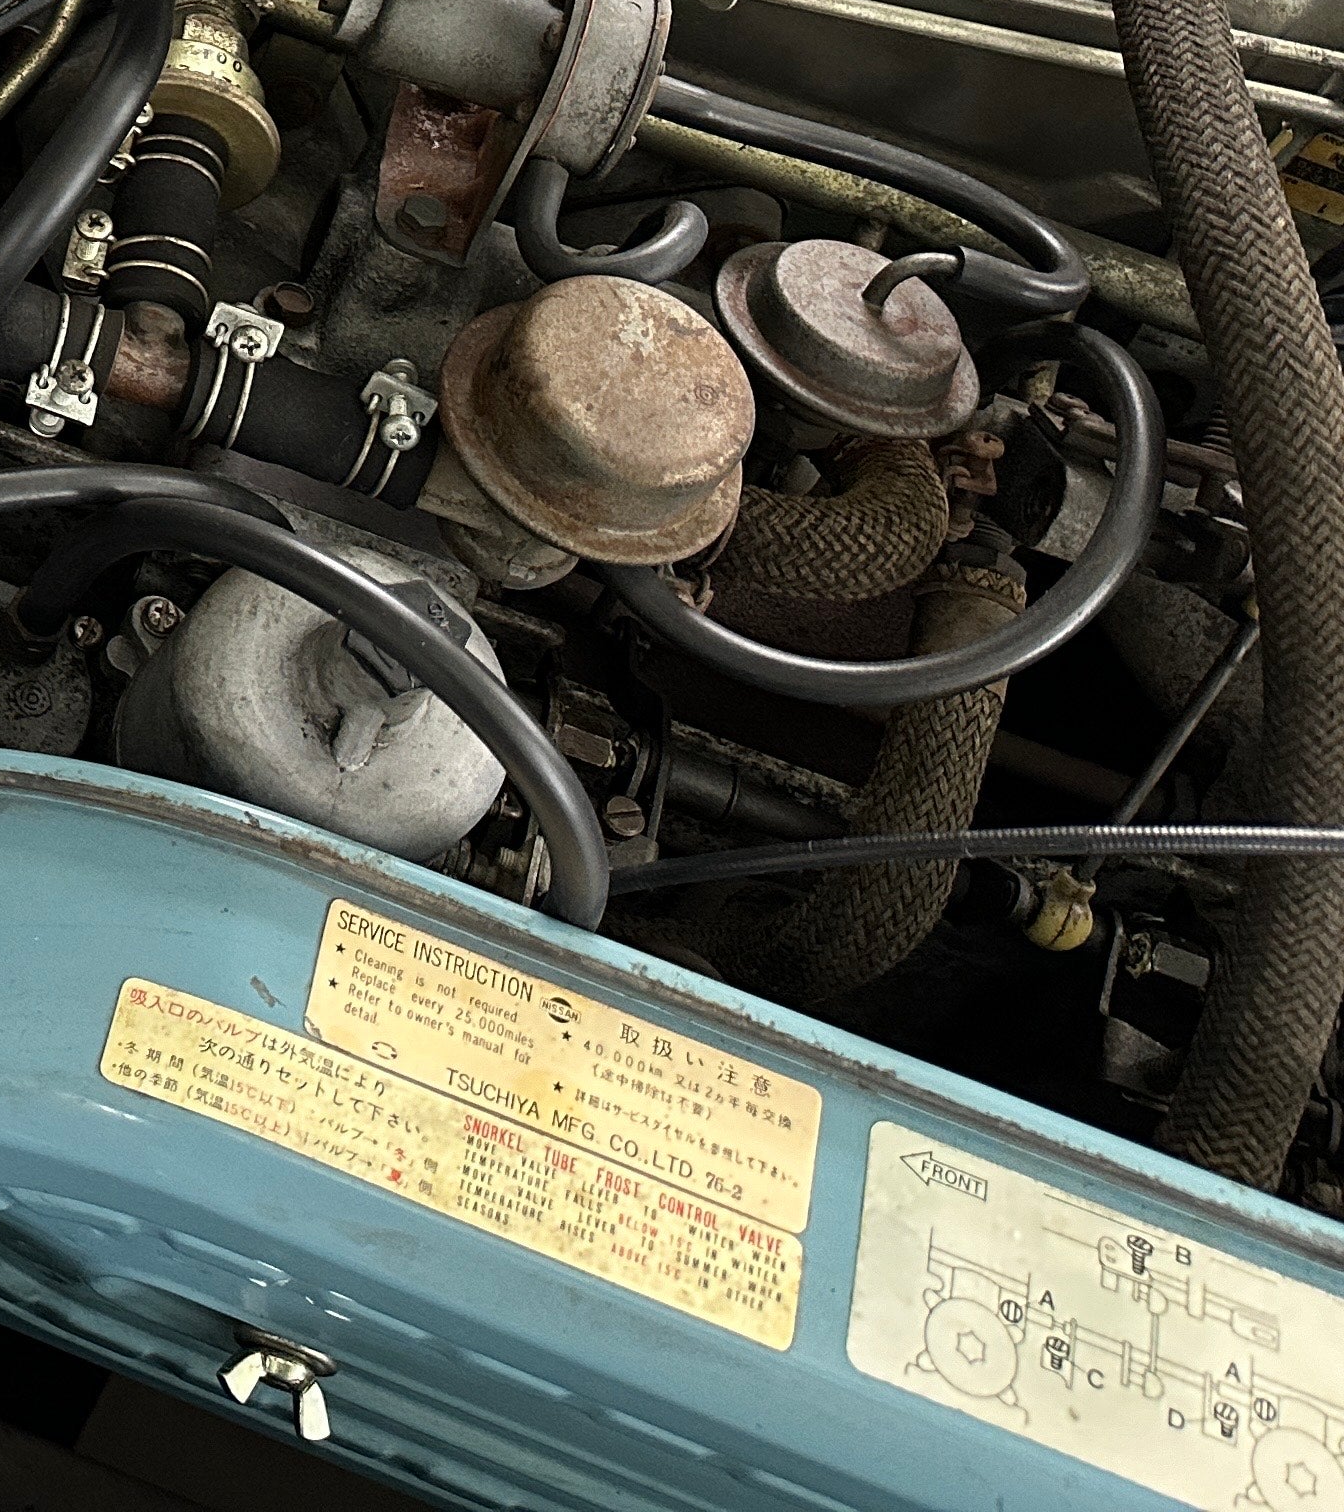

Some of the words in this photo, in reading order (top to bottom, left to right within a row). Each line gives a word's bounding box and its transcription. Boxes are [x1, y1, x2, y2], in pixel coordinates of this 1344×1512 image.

[334, 909, 410, 953] SERVICE
[409, 940, 536, 1003] INSTRUCTION
[348, 965, 398, 995] Replace
[408, 991, 445, 1015] every
[351, 947, 406, 981] Cleaning
[413, 972, 427, 987] is
[434, 980, 458, 999] not
[466, 994, 519, 1025] required
[345, 982, 382, 1008] Refer
[385, 998, 404, 1017] to
[404, 1006, 457, 1037] owner's
[459, 1029, 505, 1057] manual
[511, 1047, 532, 1066] for
[614, 1021, 776, 1099] 取扱い注意
[442, 1067, 544, 1121] TSUCHIYA
[548, 1108, 605, 1143] MFG.
[701, 1170, 746, 1202] 76-2
[459, 1113, 528, 1153] SNORKEL
[538, 1144, 581, 1174] TUBE
[592, 1167, 643, 1200] FROST
[653, 1191, 723, 1232] CONTROL
[733, 1223, 787, 1258] VALVE
[462, 1149, 550, 1192] TEMPERATURE
[563, 1189, 605, 1215] FALLS
[615, 1211, 659, 1238] BELOW
[464, 1134, 498, 1157] MOVE
[518, 1156, 559, 1181] VALVE
[579, 1180, 621, 1205] LEVER
[641, 1205, 659, 1221] TO
[686, 1223, 736, 1252] WINTER
[920, 1160, 983, 1196] FRONT
[456, 1178, 545, 1223] TEMPERATURE
[557, 1218, 597, 1244] RISES
[724, 1287, 766, 1311] OTHER
[460, 1164, 495, 1186] MOVE
[513, 1185, 556, 1211] VALVE
[575, 1210, 618, 1236] LEVER
[638, 1235, 656, 1252] TO
[674, 1249, 730, 1281] SUMMER
[1175, 1245, 1193, 1267] B
[1037, 1289, 1056, 1311] A
[1087, 1368, 1105, 1390] C
[1224, 1361, 1242, 1381] A
[1167, 1407, 1186, 1430] D
